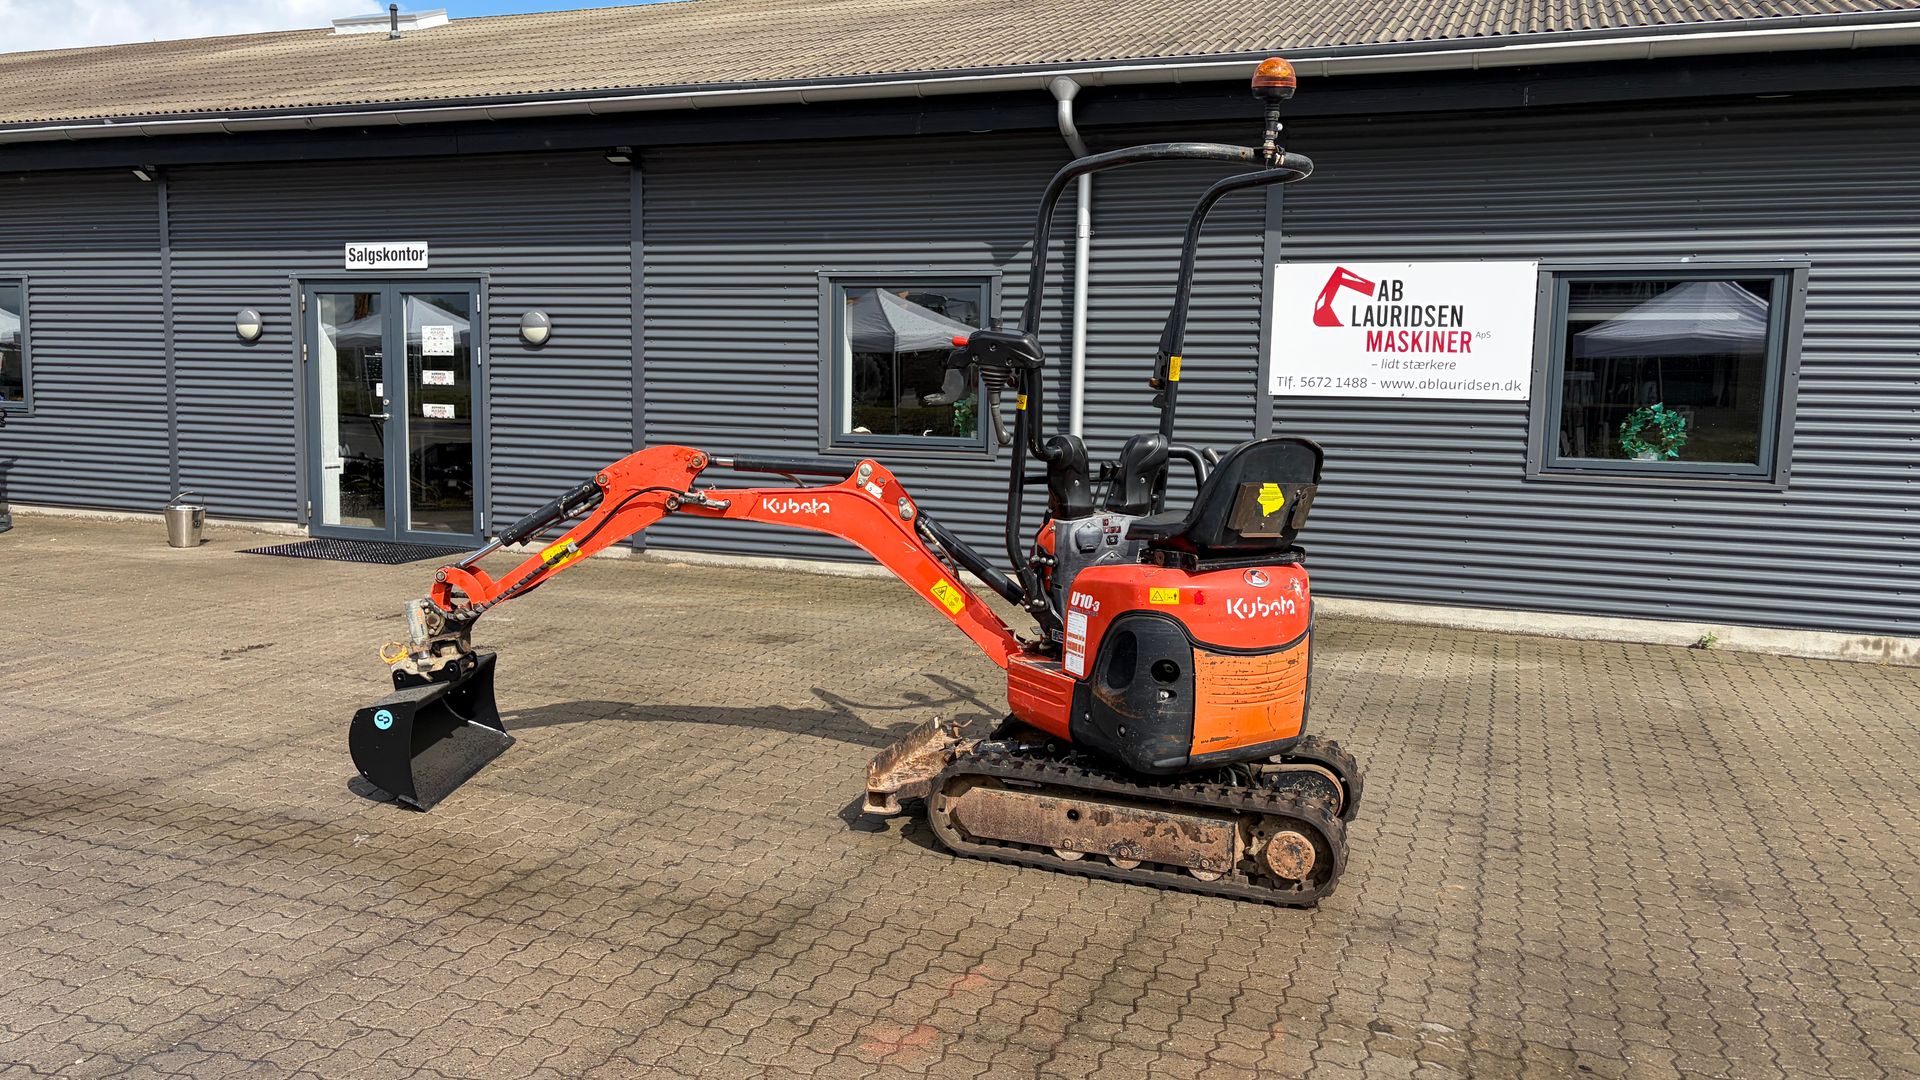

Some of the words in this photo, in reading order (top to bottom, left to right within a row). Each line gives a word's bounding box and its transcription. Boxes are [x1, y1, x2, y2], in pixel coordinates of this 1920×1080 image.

[348, 246, 425, 265] Salgskontor
[1377, 279, 1404, 302] AB
[1351, 304, 1464, 328] LAURIDSEN
[1366, 330, 1472, 353] MASKINER
[1475, 330, 1492, 340] ApS
[1381, 358, 1400, 370] lidt
[1402, 359, 1457, 371] stærkere
[1276, 376, 1296, 389] Tlf.
[1300, 376, 1332, 389] 5672
[1335, 377, 1368, 389] 1488
[1380, 377, 1523, 393] www.ablauridsen.dk
[762, 498, 830, 515] Kubota
[1070, 591, 1101, 613] U10-3
[1226, 596, 1296, 619] Kubota
